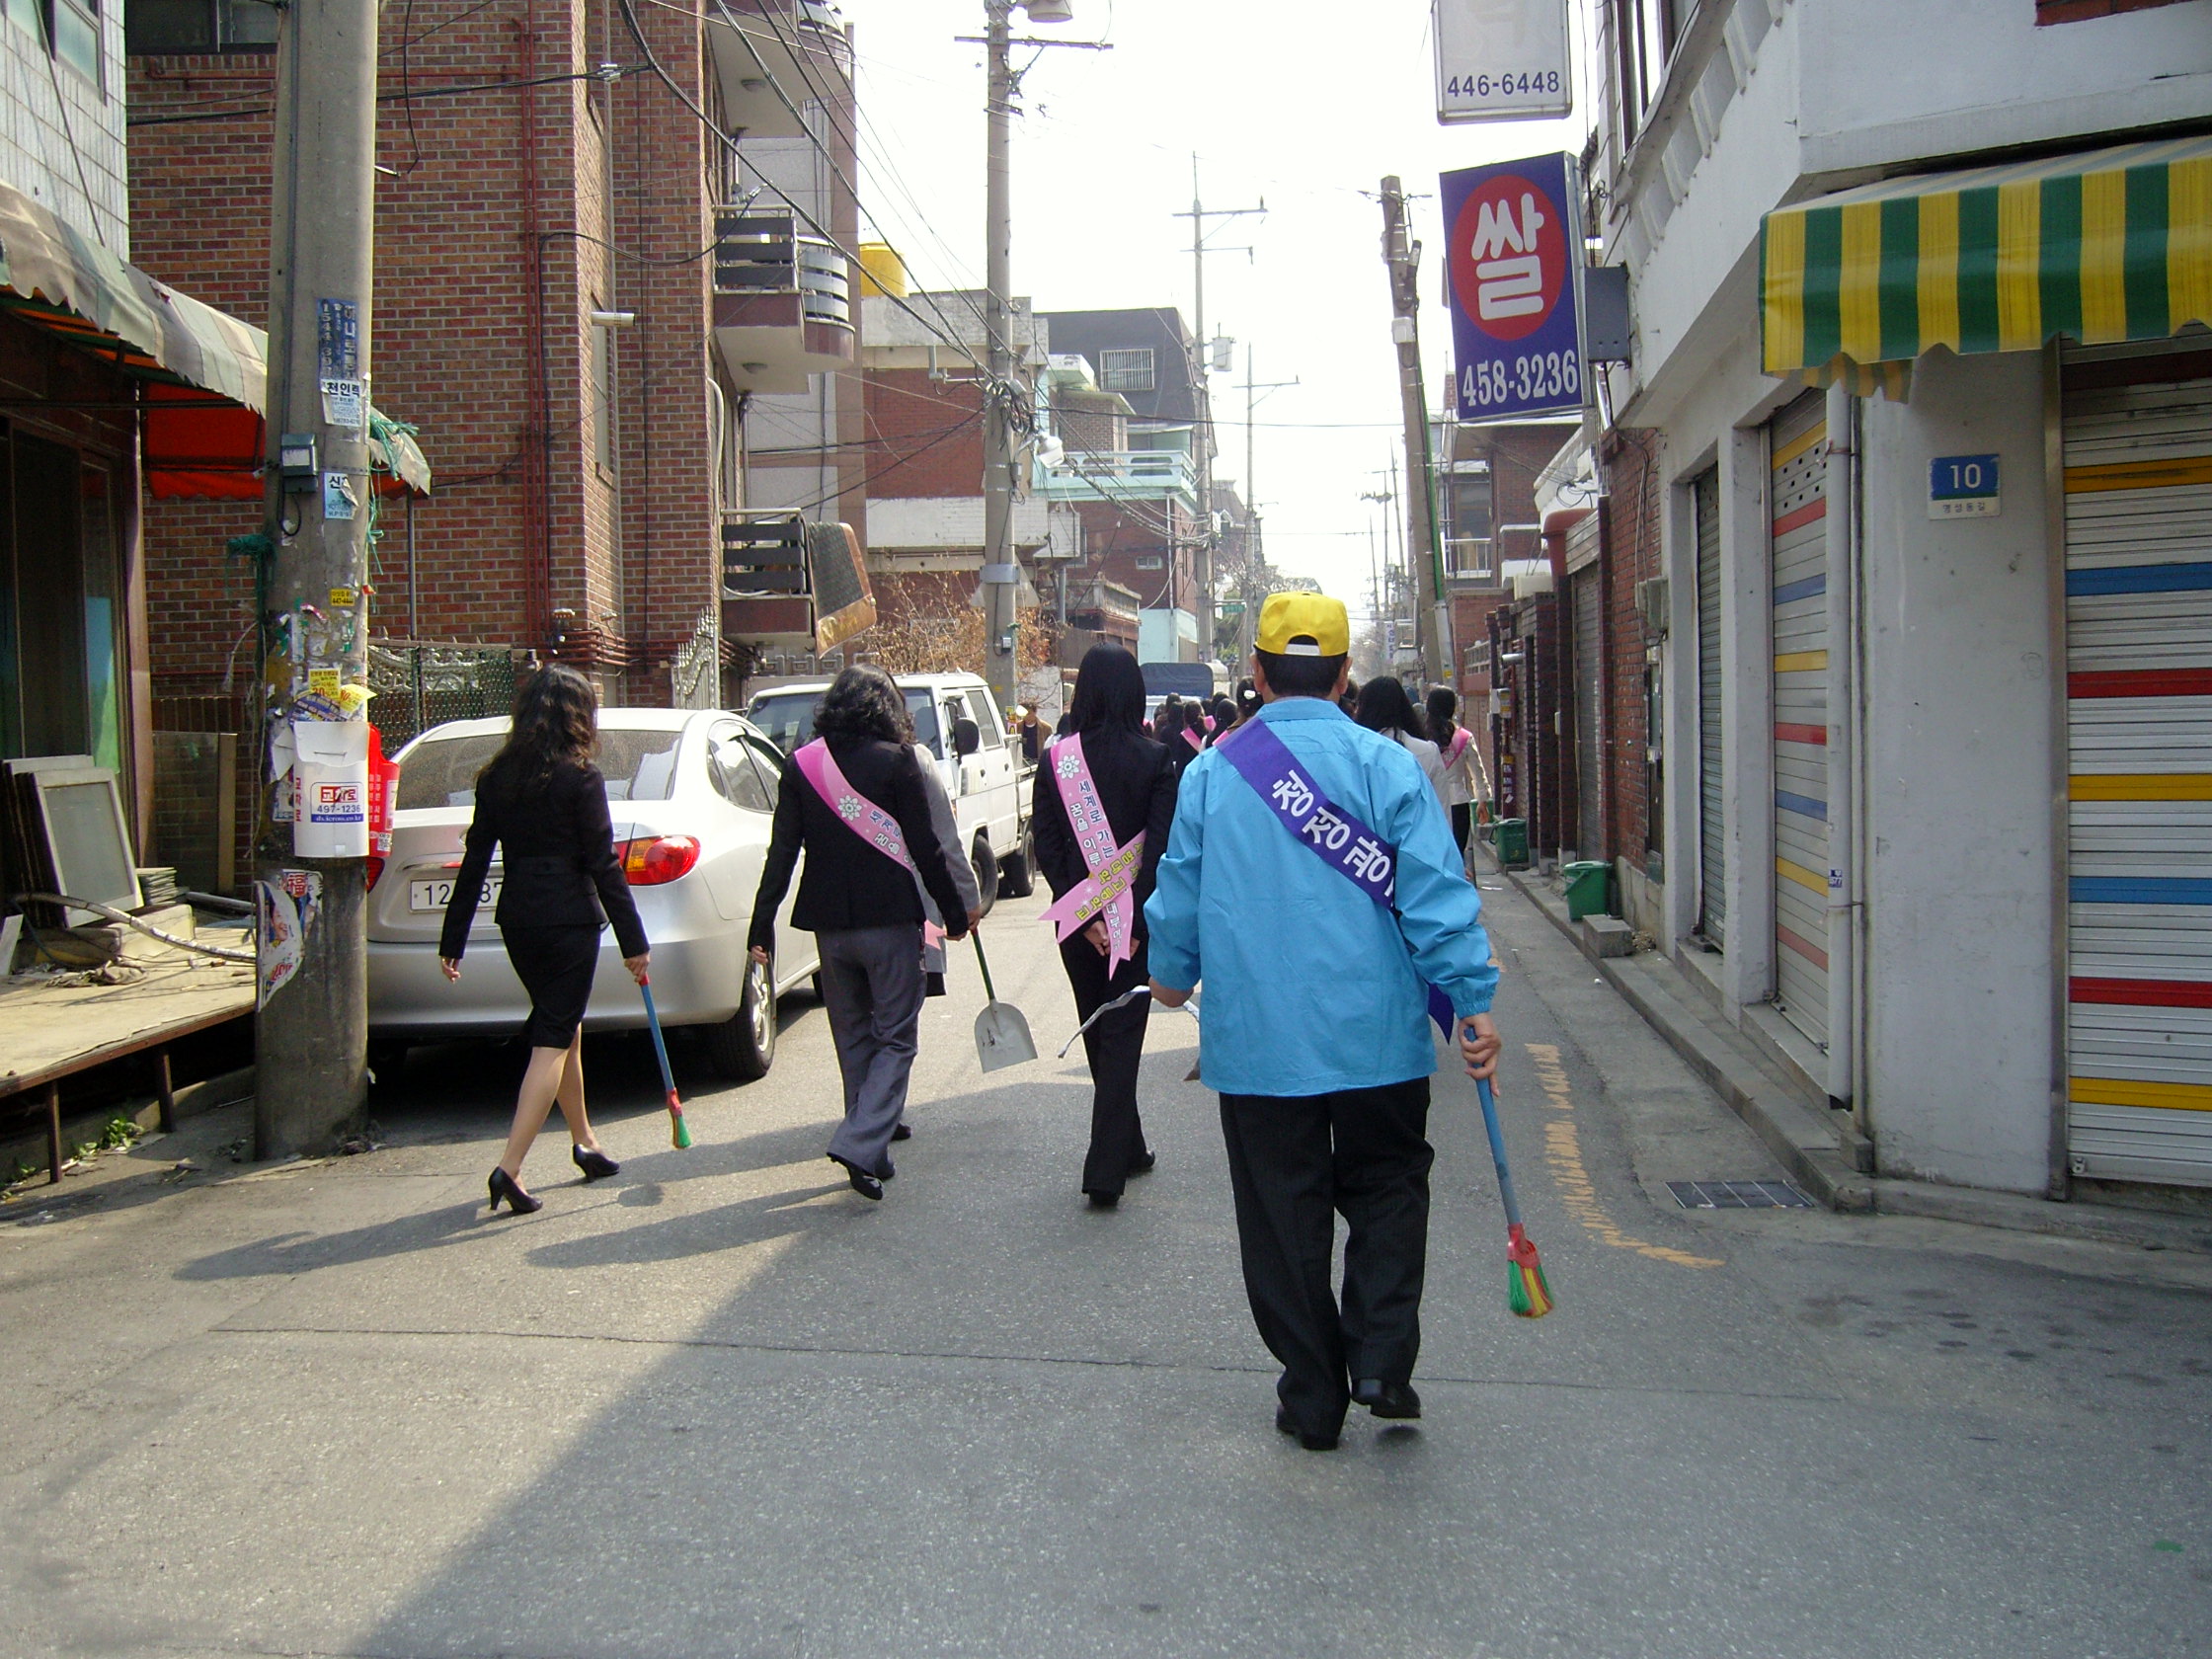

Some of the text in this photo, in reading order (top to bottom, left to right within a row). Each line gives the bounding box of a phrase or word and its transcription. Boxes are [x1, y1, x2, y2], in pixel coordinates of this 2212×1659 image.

[1447, 70, 1559, 97] 446-6448
[1471, 193, 1543, 320] 쌀
[1462, 349, 1578, 407] 458-3236
[1949, 463, 1981, 489] 10
[317, 804, 361, 813] 497-1236
[1069, 802, 1090, 832] 꿈을
[1078, 779, 1116, 859] 세계로 가는
[1272, 769, 1394, 907] 청정광
[1074, 877, 1127, 921] 고등학교
